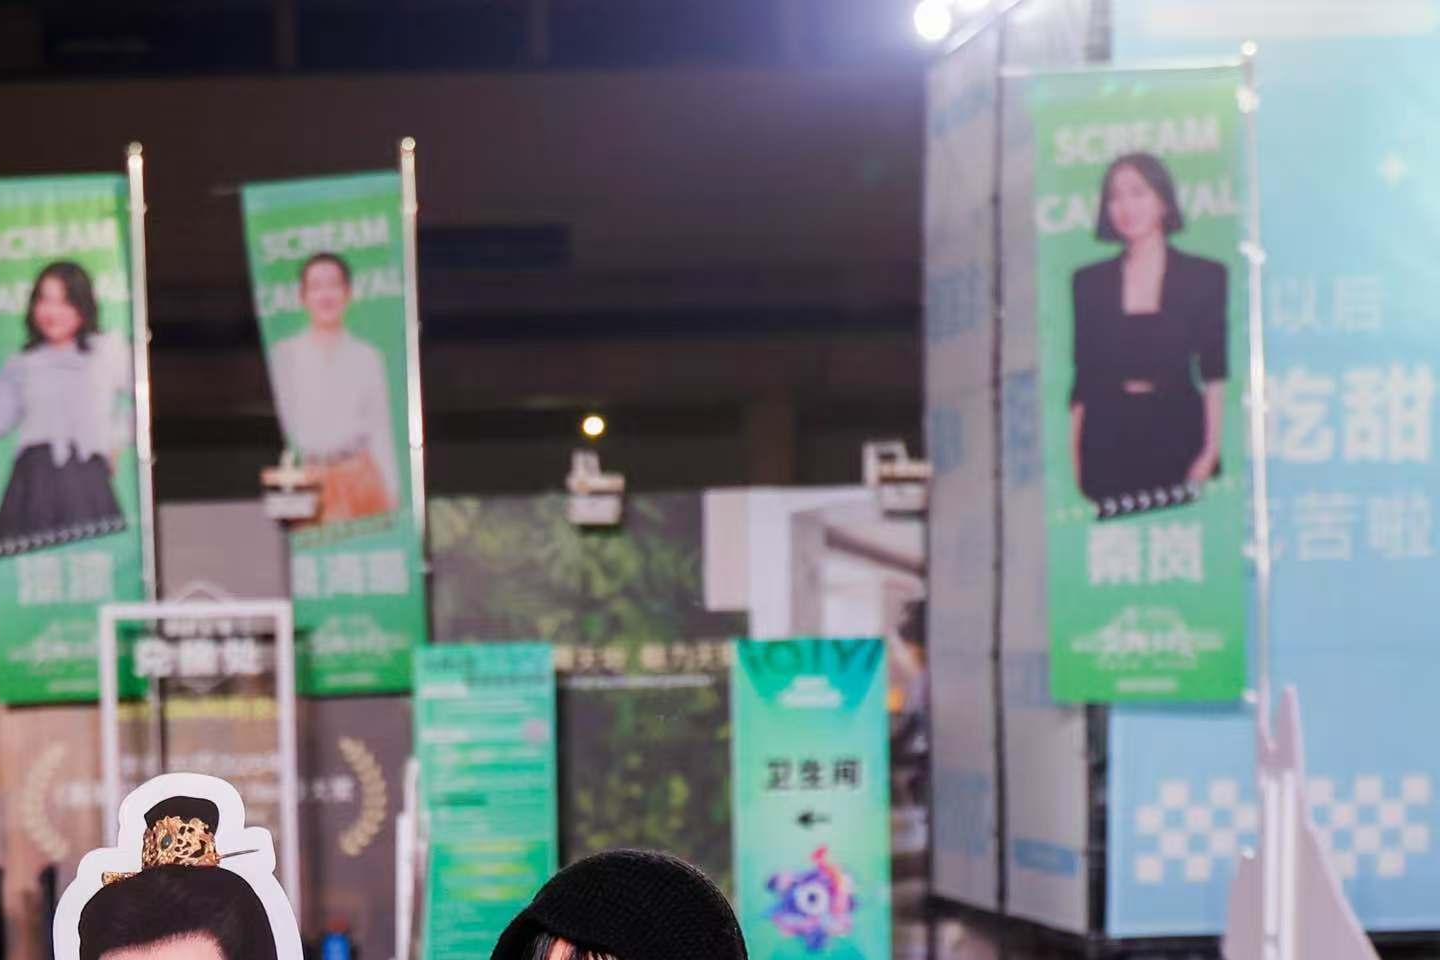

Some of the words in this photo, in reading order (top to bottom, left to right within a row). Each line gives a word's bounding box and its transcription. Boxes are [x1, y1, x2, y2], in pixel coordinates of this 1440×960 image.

[1053, 114, 1219, 164] SCREAM
[261, 213, 389, 262] SCREAM
[765, 757, 862, 791] 卫生间
